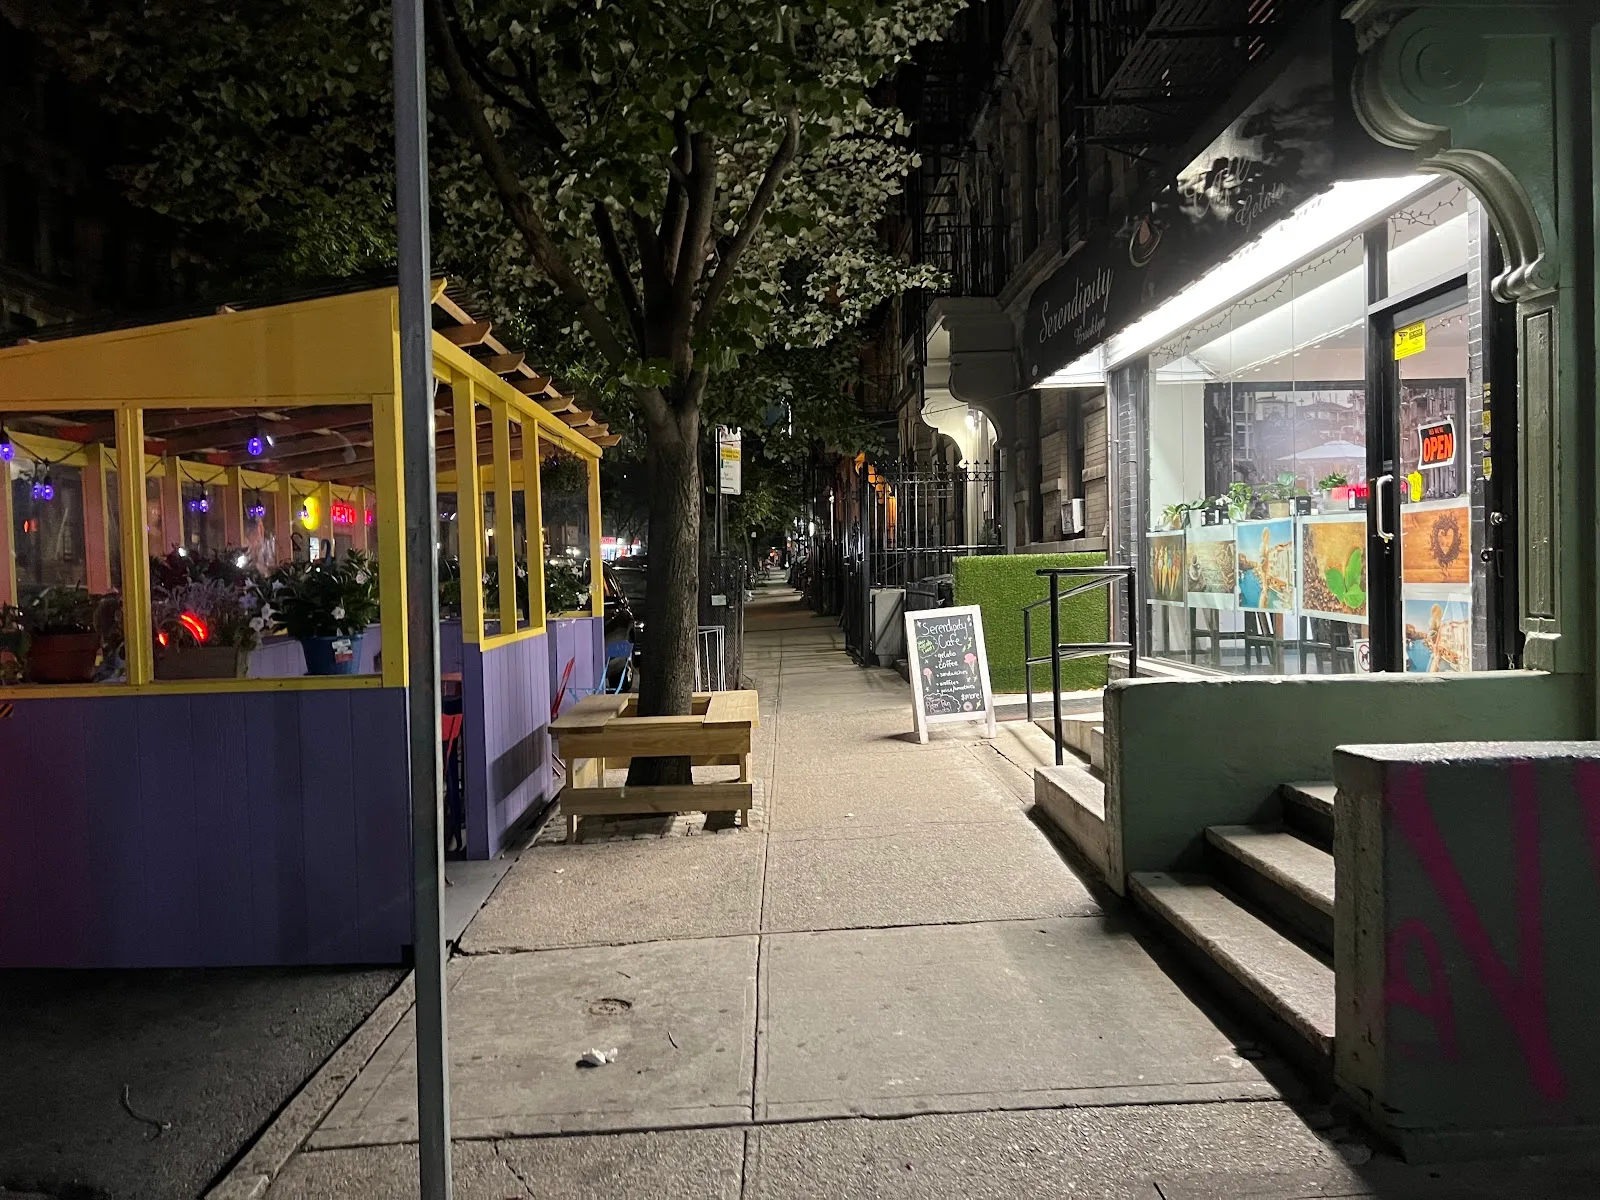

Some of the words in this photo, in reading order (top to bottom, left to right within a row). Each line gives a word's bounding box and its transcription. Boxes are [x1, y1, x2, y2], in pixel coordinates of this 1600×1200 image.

[1039, 266, 1114, 344] Serendipity
[1423, 433, 1452, 462] OPEN
[922, 619, 968, 640] Serendipity
[938, 650, 957, 663] gelato
[938, 660, 959, 670] coffee
